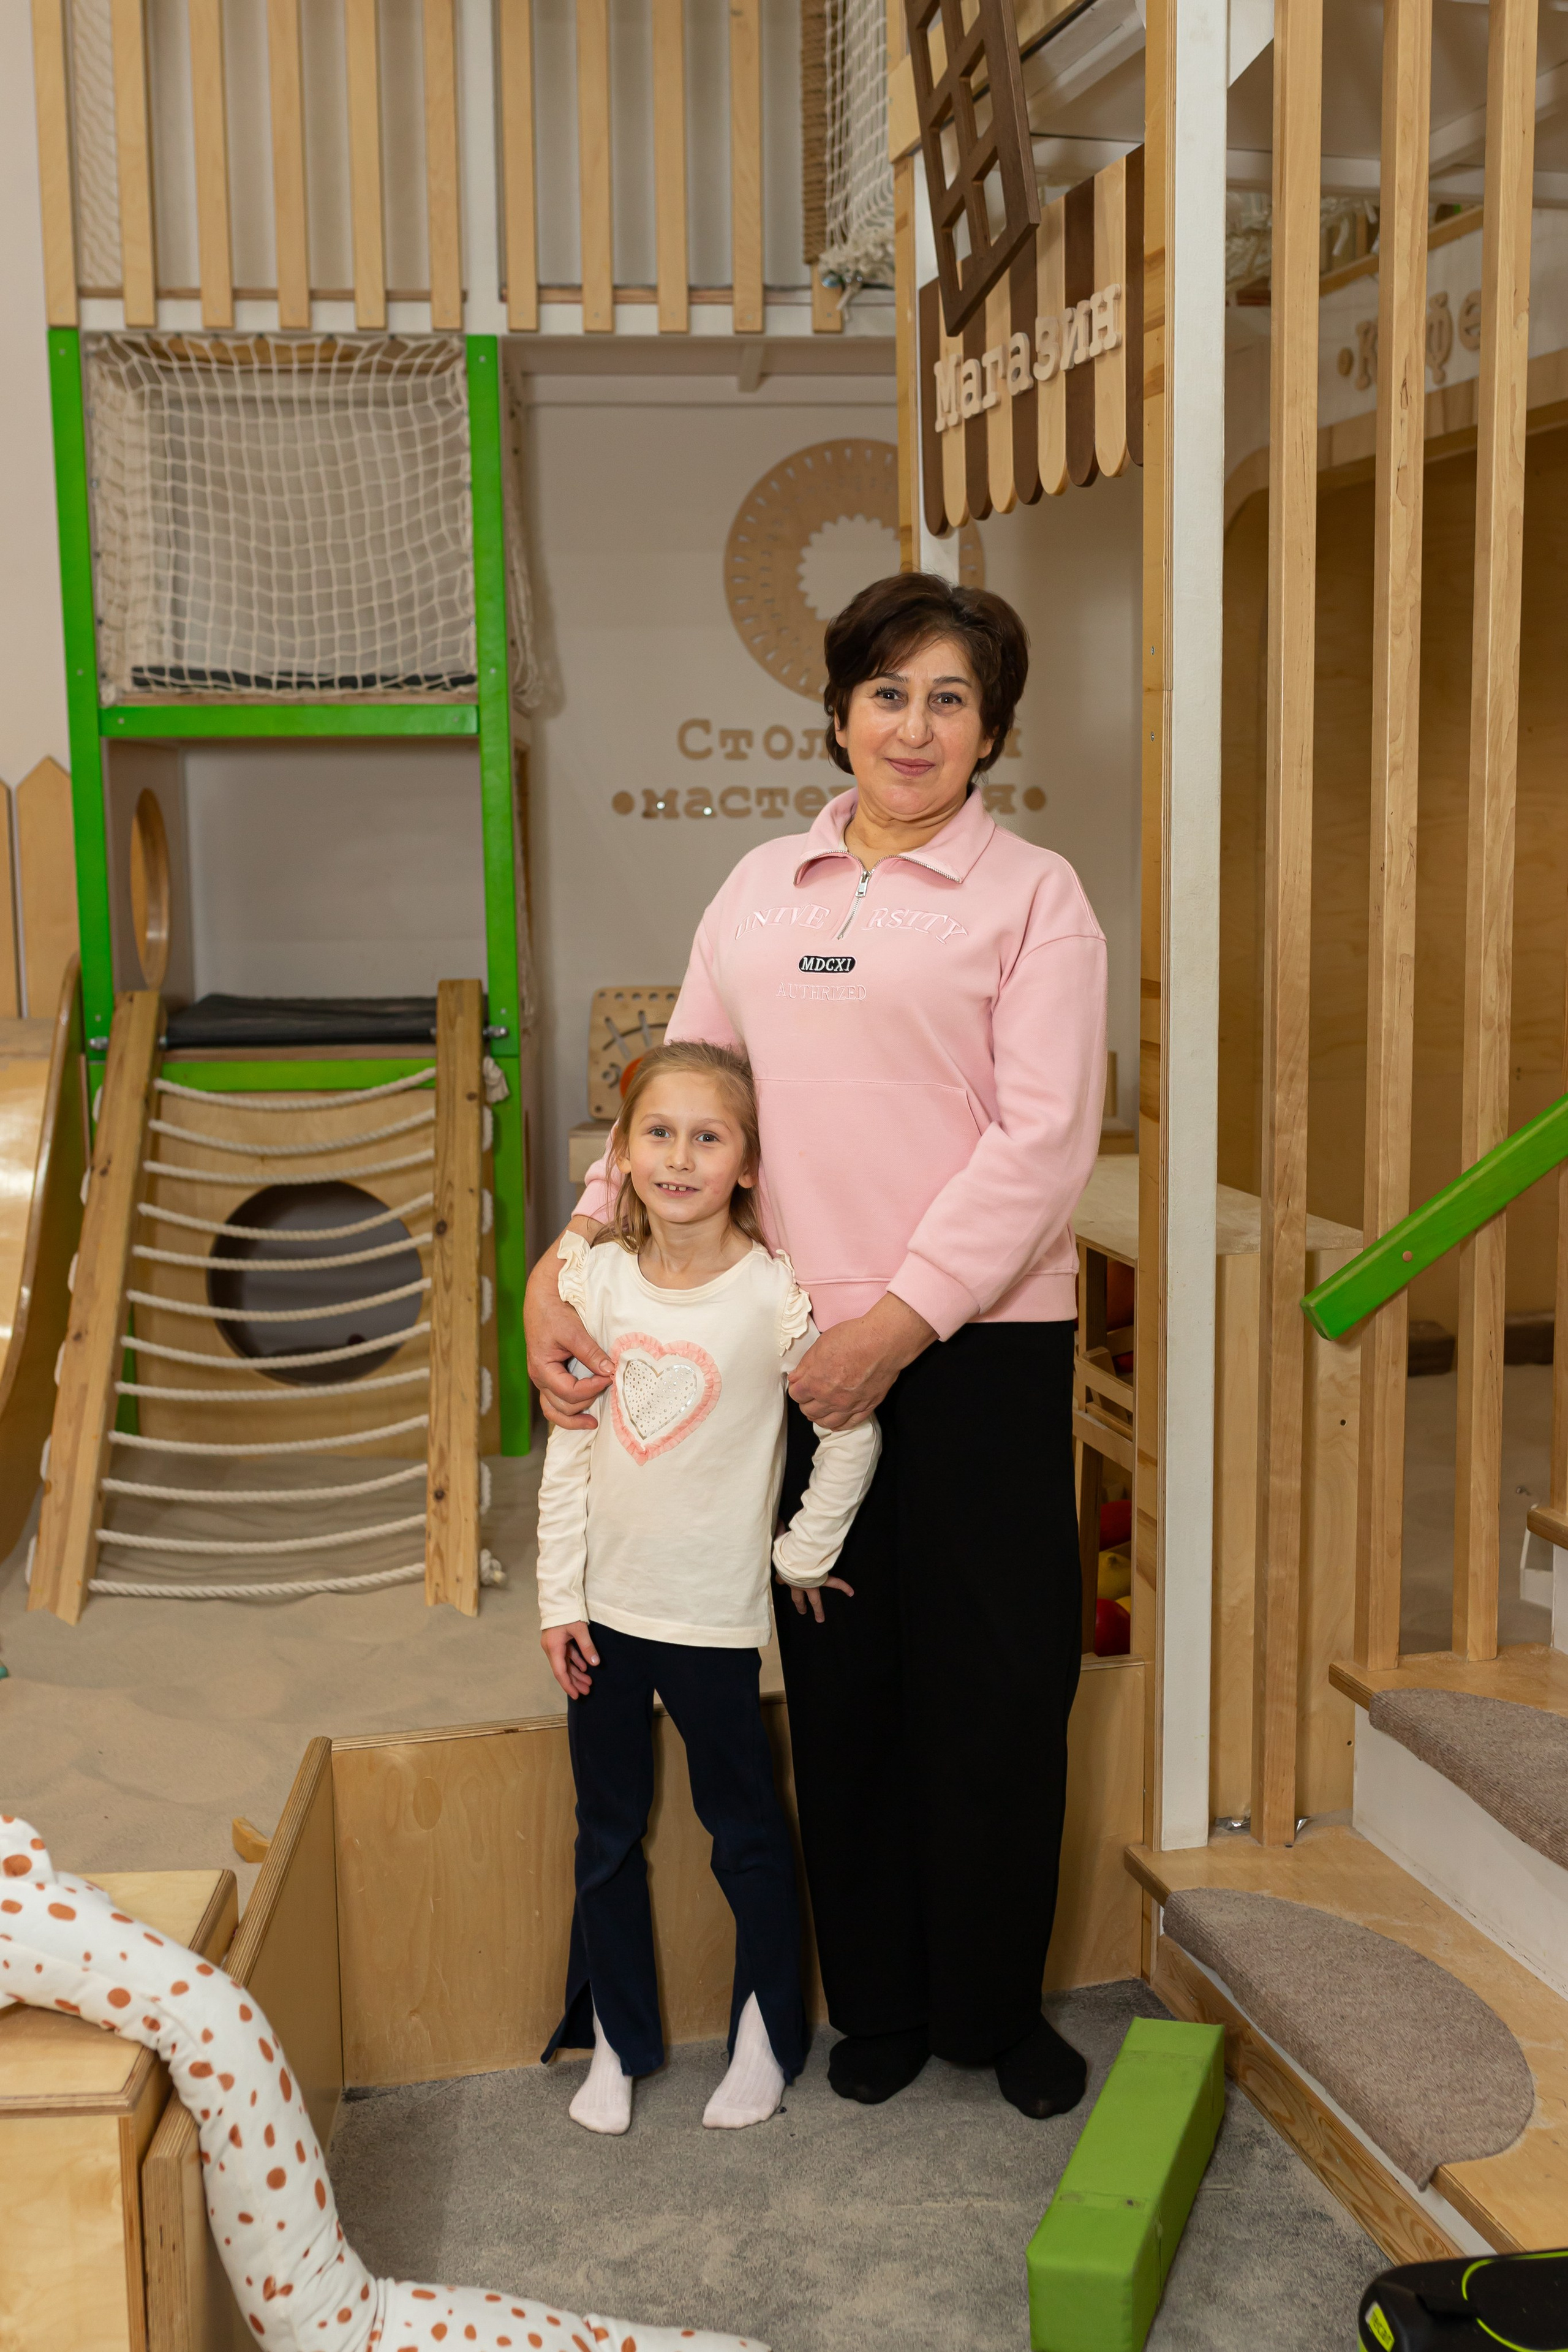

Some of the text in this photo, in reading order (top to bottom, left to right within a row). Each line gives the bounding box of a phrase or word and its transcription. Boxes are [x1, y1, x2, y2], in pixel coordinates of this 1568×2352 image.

[933, 284, 1122, 432] Магазин
[861, 907, 969, 944] RSITY
[800, 957, 851, 972] MDCXI
